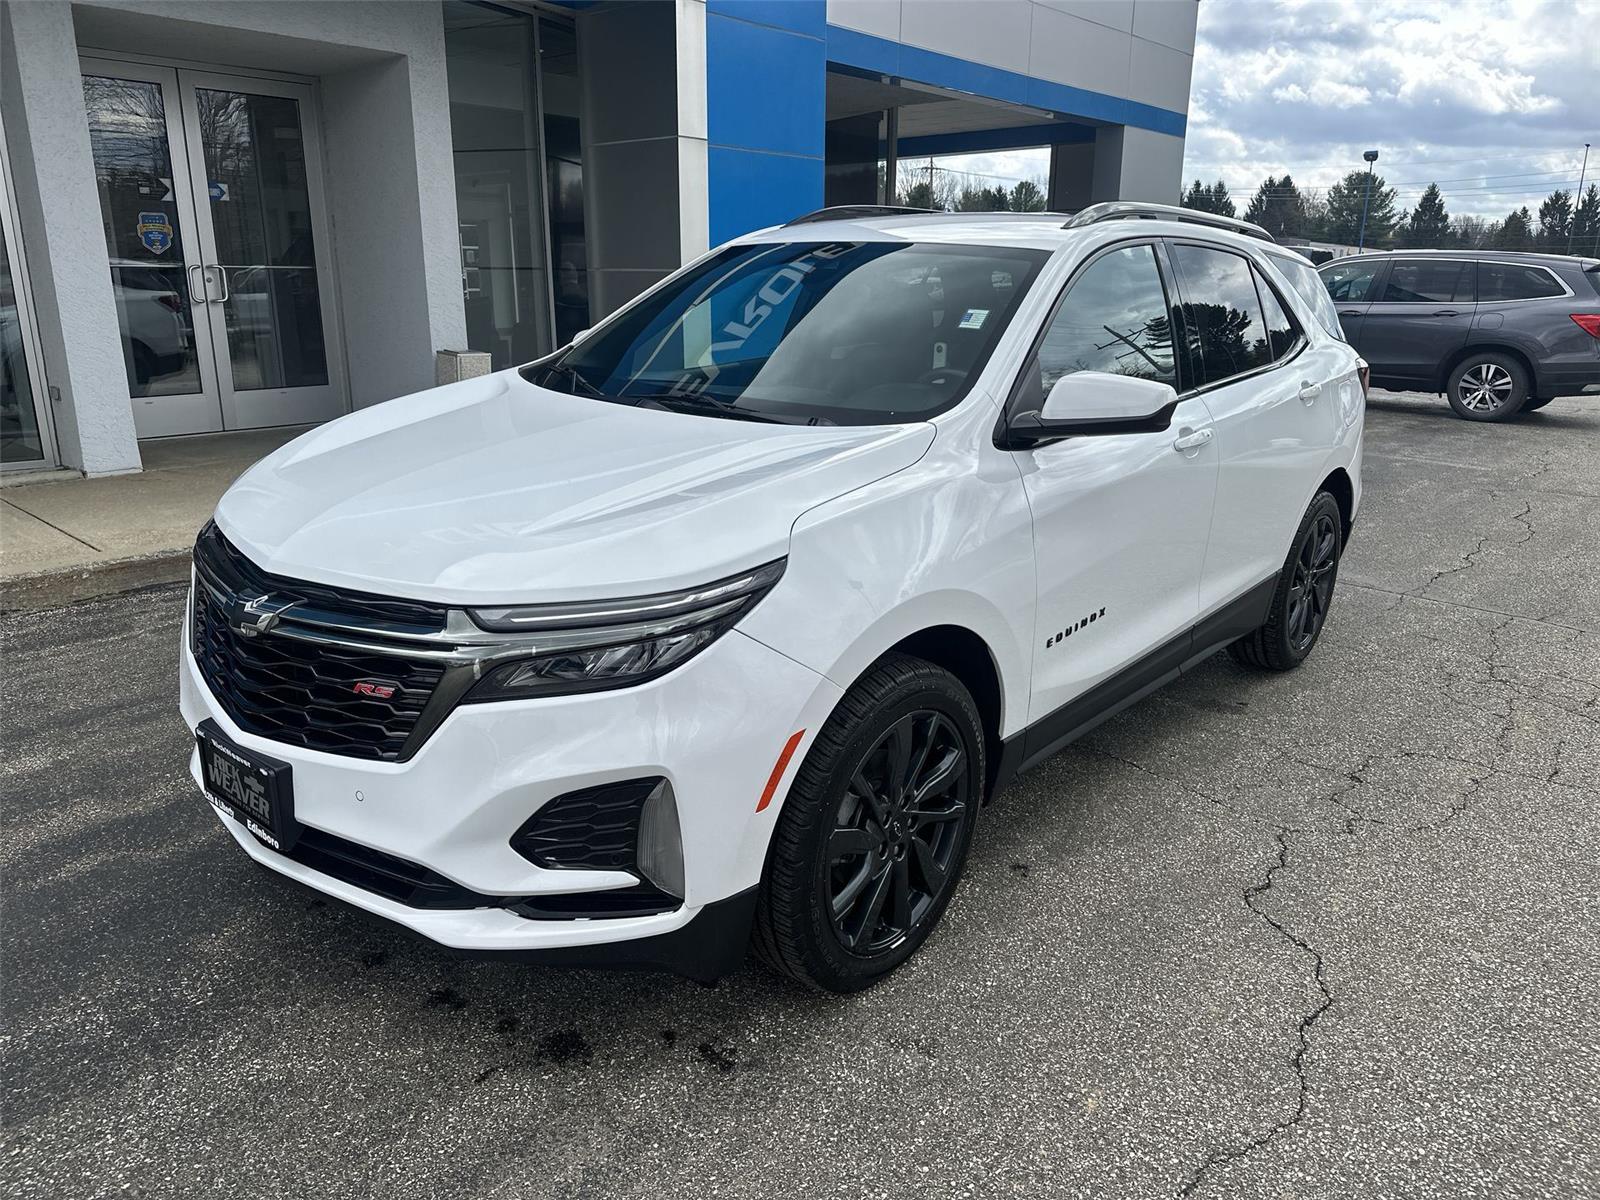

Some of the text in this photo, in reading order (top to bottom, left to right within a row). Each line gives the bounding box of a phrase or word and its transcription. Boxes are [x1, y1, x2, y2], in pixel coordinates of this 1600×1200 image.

[1046, 606, 1106, 649] EQUINOX
[352, 681, 396, 699] RS
[213, 751, 240, 780] RICK
[208, 763, 270, 819] WEAVER
[247, 819, 280, 849] Edinboro
